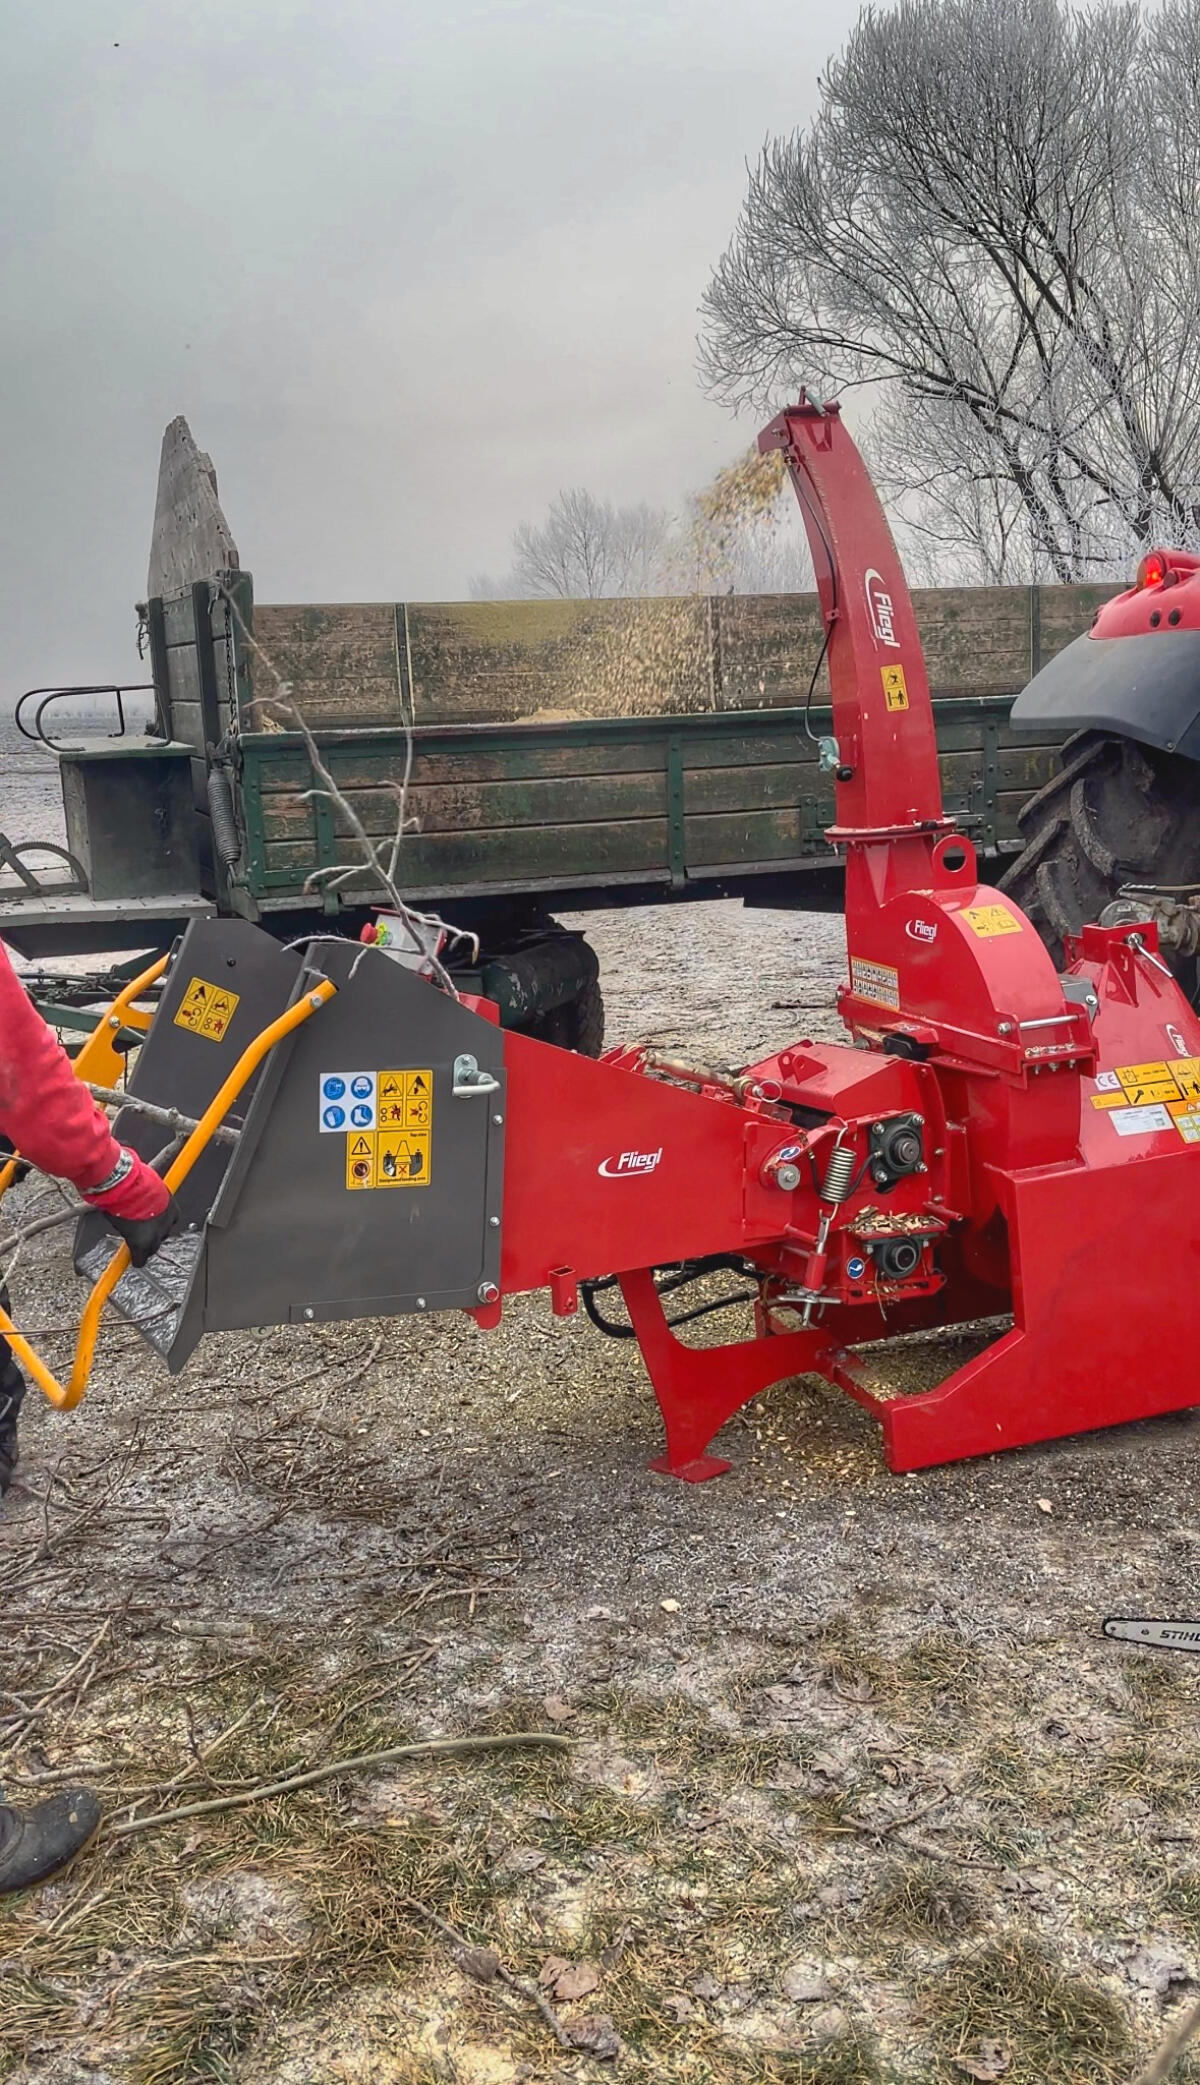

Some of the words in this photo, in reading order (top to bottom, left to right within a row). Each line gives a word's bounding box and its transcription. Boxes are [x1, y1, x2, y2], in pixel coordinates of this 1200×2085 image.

[873, 591, 901, 648] Fliegl
[914, 919, 938, 940] Fliegl
[617, 1147, 663, 1170] Fliegl
